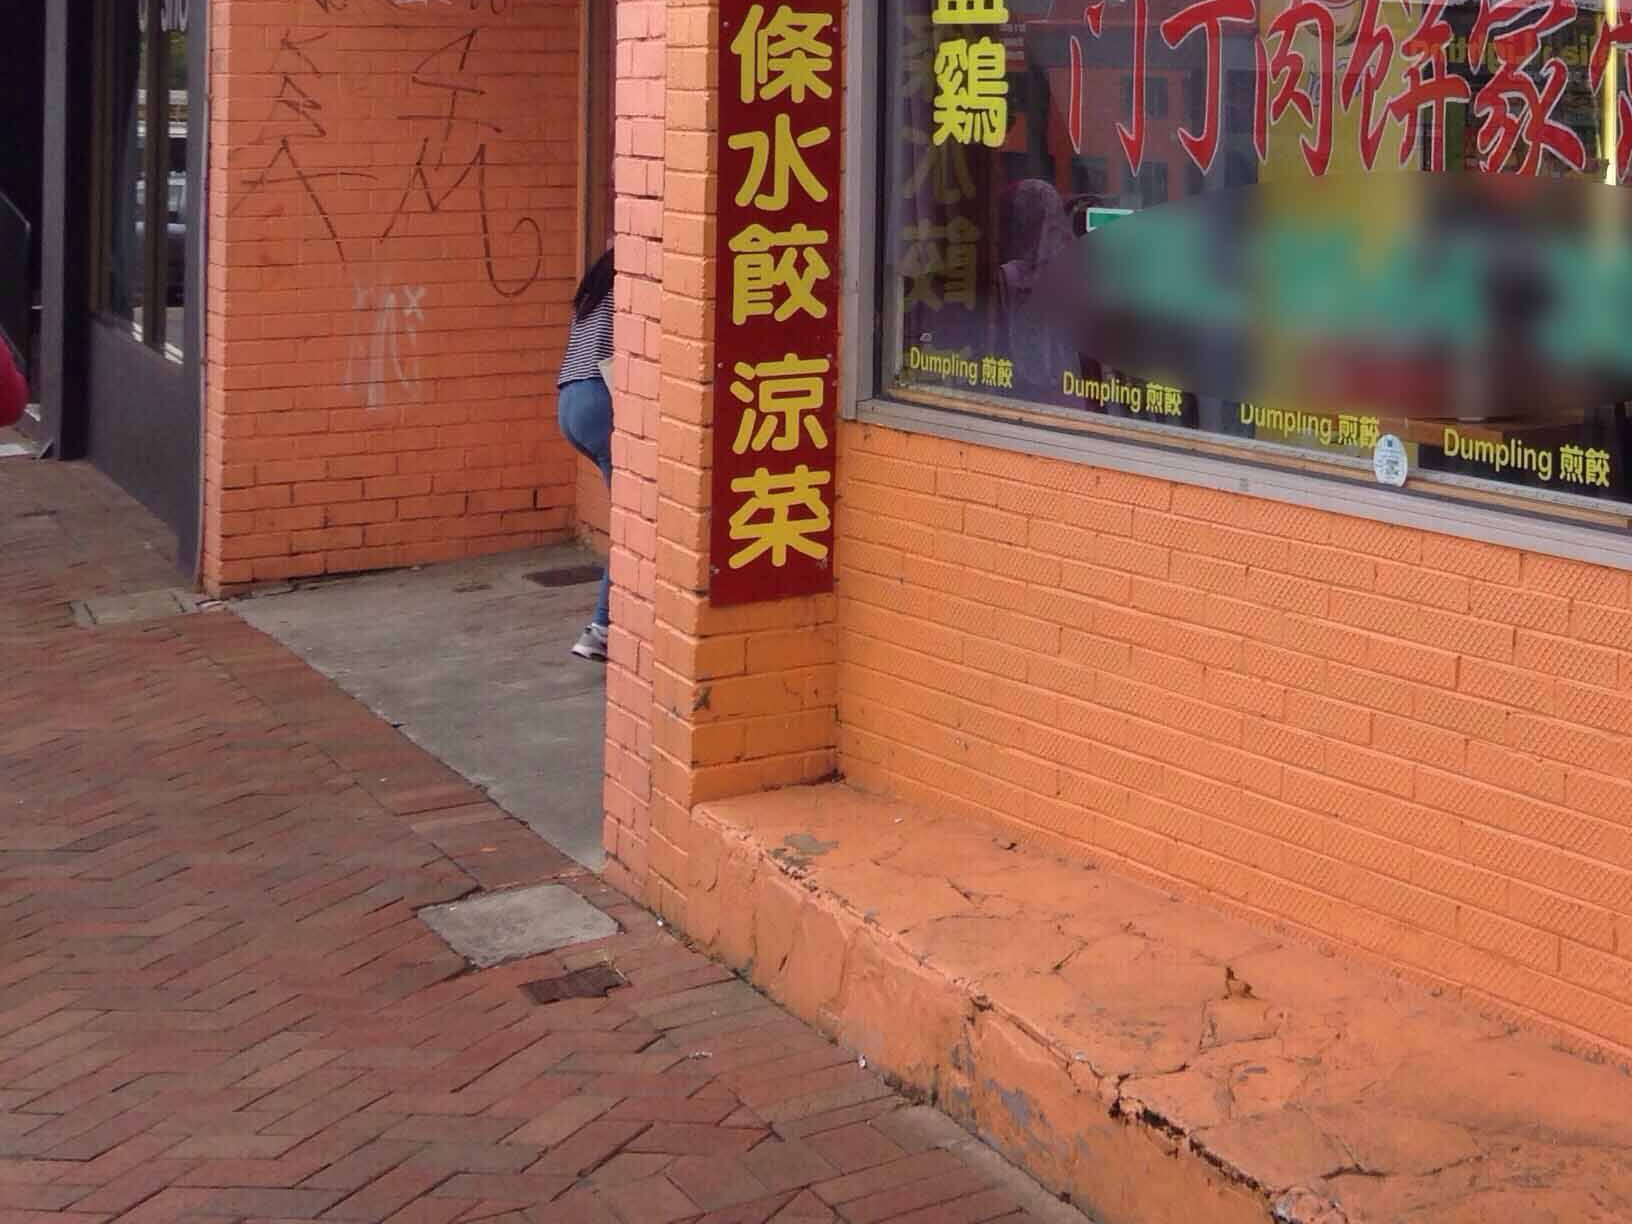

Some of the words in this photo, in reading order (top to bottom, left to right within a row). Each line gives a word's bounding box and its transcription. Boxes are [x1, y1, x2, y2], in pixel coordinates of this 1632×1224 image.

[909, 345, 978, 386] Dumpling
[1063, 370, 1142, 413] Dumpling
[1240, 402, 1332, 446] Dumpling
[1443, 427, 1553, 481] Dumpling
